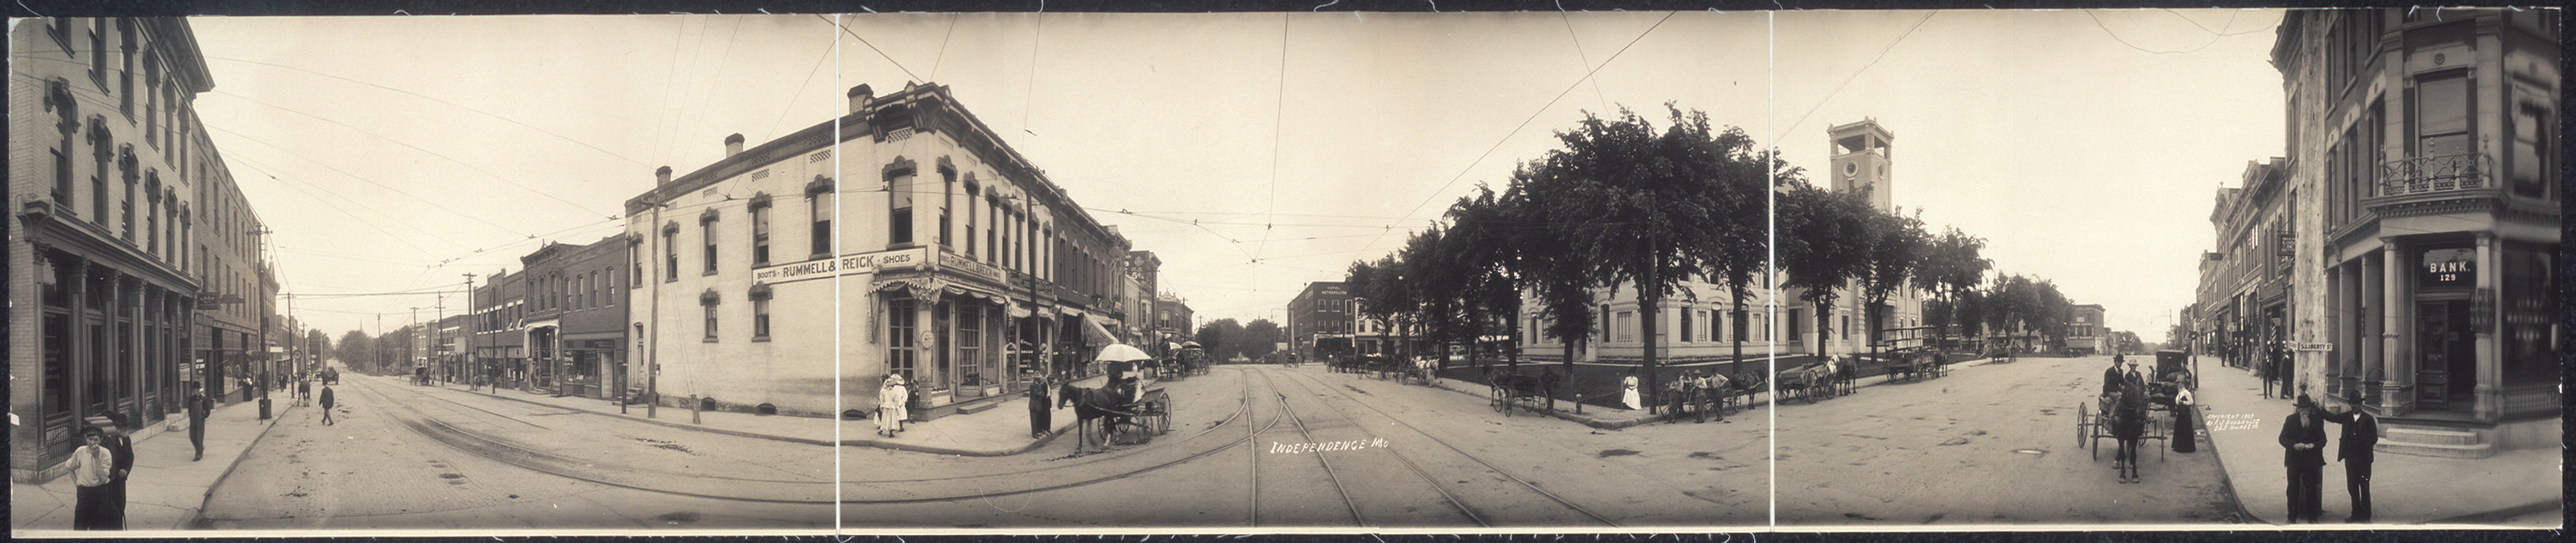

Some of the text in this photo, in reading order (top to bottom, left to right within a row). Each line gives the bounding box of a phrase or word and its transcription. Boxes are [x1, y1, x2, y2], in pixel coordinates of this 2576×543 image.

[757, 271, 777, 280] BOOTS
[782, 262, 828, 278] RUMMELL
[842, 255, 875, 271] REICK
[883, 254, 910, 264] SHOES
[2429, 262, 2471, 273] BANK.
